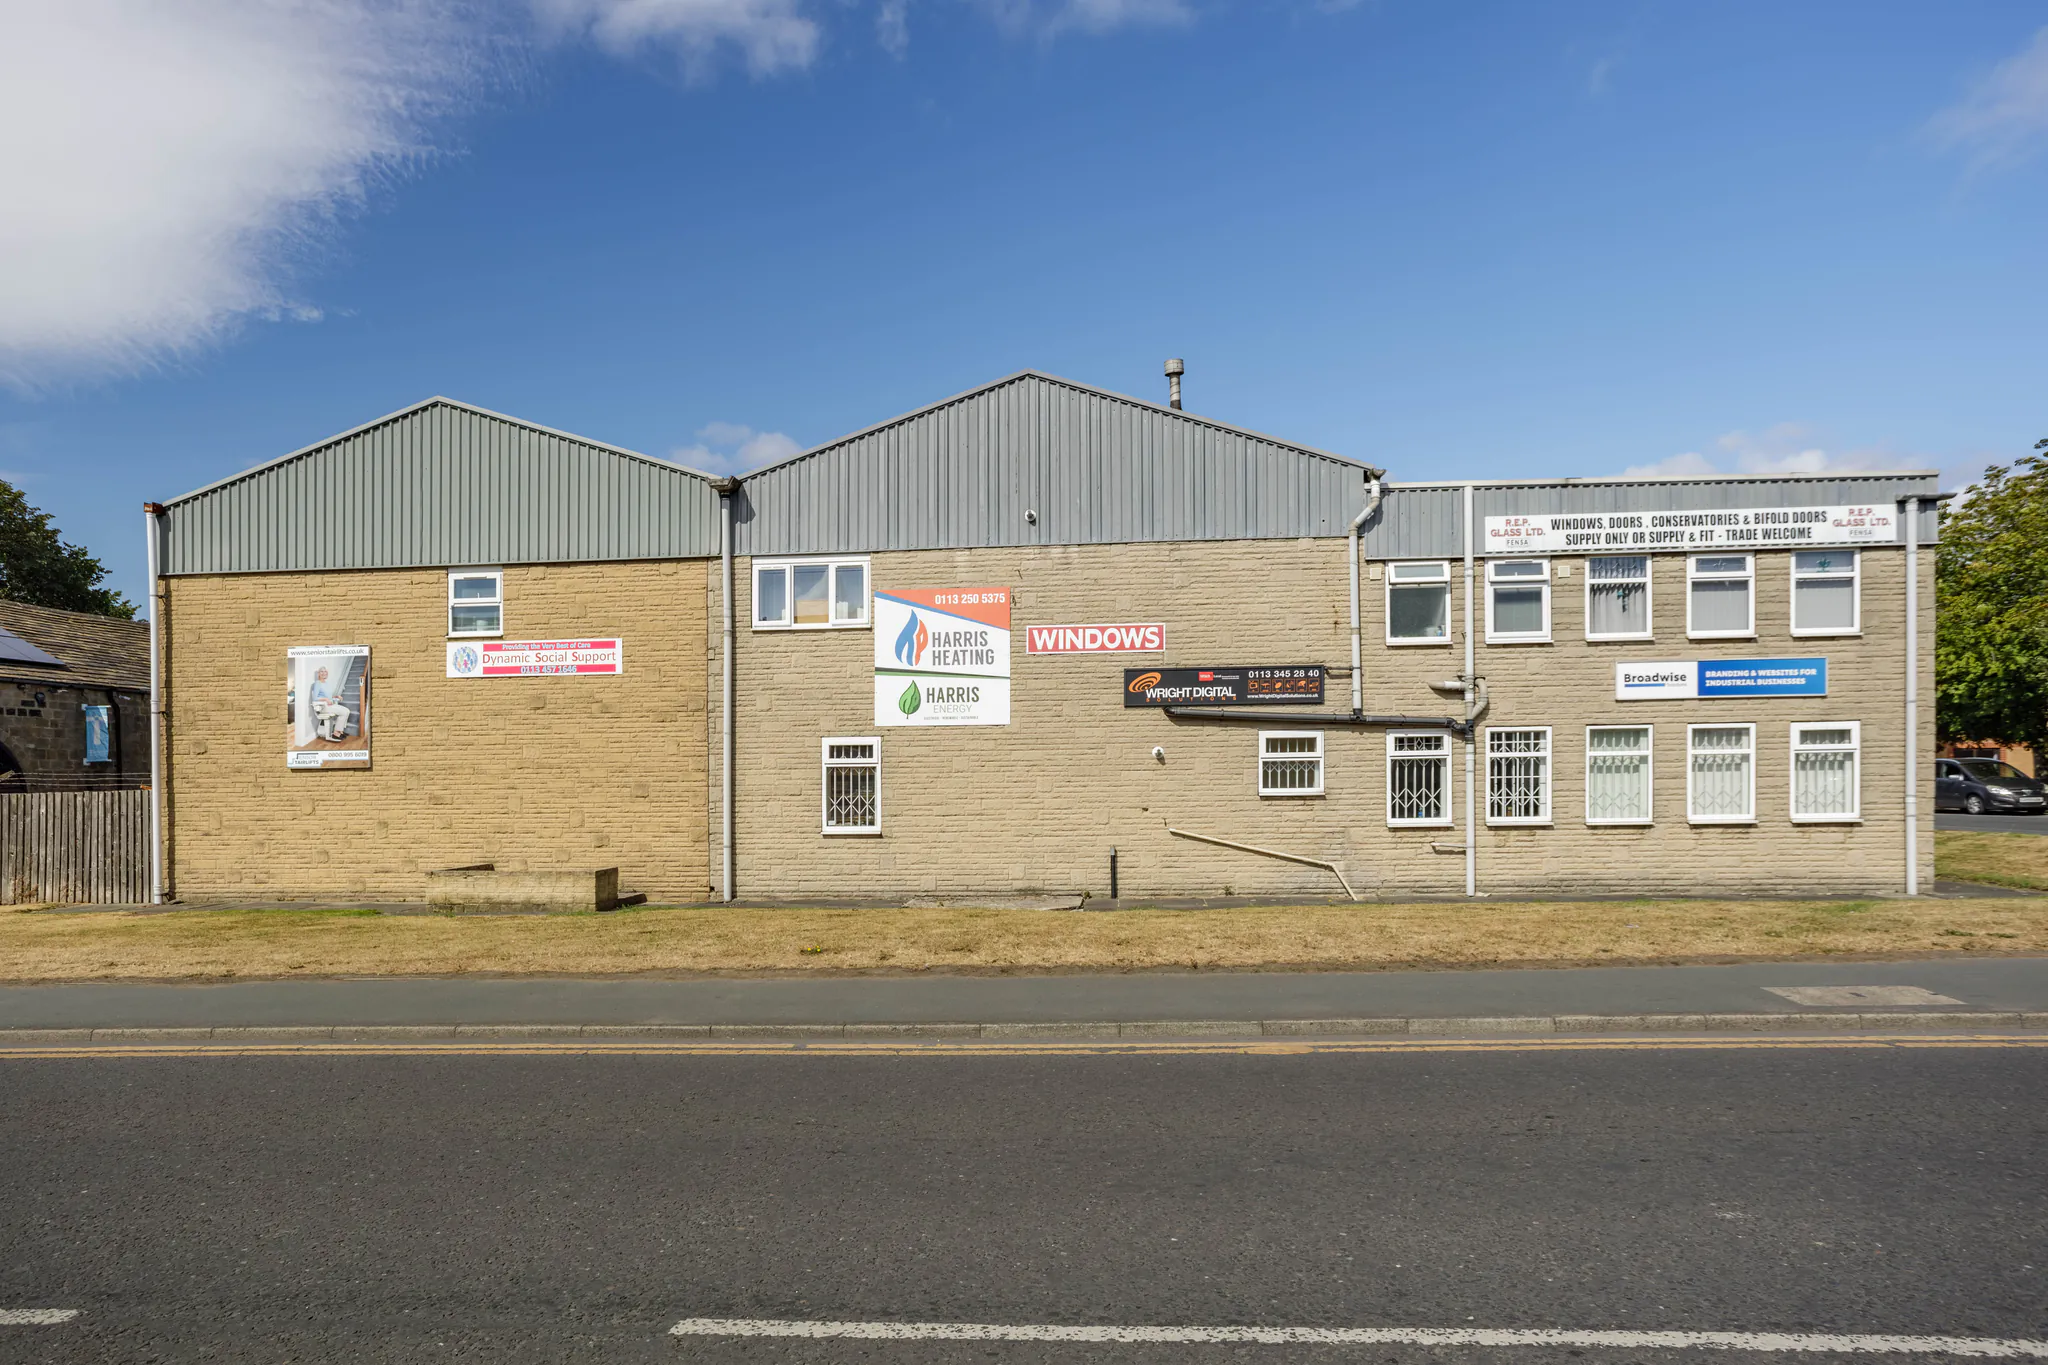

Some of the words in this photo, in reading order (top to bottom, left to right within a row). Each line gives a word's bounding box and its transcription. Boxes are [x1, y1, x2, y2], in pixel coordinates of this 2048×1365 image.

[1505, 518, 1531, 527] R.E.P.
[1652, 513, 1739, 528] CONSERVATORIES
[1743, 514, 1751, 525] &
[1754, 512, 1789, 524] BIFOLD
[1792, 510, 1828, 523] DOORS
[1832, 518, 1865, 527] GLASS
[1870, 517, 1892, 526] LTD.
[1490, 528, 1522, 537] GLASS
[1525, 527, 1546, 536] LTD.
[1565, 532, 1602, 546] SUPPLY
[1605, 532, 1629, 545] ONLY
[1632, 531, 1646, 544] OR
[1649, 530, 1685, 543] SUPPLY
[1688, 531, 1696, 543] &
[1699, 529, 1715, 542] FIT
[1725, 528, 1758, 541] TRADE
[1761, 526, 1813, 540] WELCOME
[934, 594, 959, 605] 0113
[961, 593, 979, 604] 250
[981, 592, 1006, 604] 5375
[932, 630, 988, 648] HARRIS
[1032, 626, 1160, 650] WINDOWS
[502, 643, 529, 651] Providing
[542, 642, 555, 650] Very
[482, 653, 530, 666] Dynamic
[535, 651, 567, 663] Social
[571, 651, 616, 664] Support
[932, 648, 995, 666] HEATING
[520, 665, 540, 674] 0113
[542, 664, 556, 673] 457
[1248, 670, 1271, 678] 0113
[1273, 670, 1291, 678] 345
[1293, 669, 1305, 678] 28
[1307, 669, 1320, 677] 40
[1705, 669, 1750, 678] BRANDING
[1751, 669, 1757, 677] &
[1757, 668, 1799, 677] WEBSITES
[1800, 668, 1817, 676] FOR
[1624, 672, 1687, 683] Broadwise
[1705, 678, 1756, 687] INDUSTRIAL
[1757, 677, 1806, 686] BUSINESSES
[926, 686, 980, 703] HARRIS
[1145, 687, 1192, 698] WRIGHT
[1193, 686, 1236, 697] DIGITAL
[933, 704, 972, 714] ENERGY
